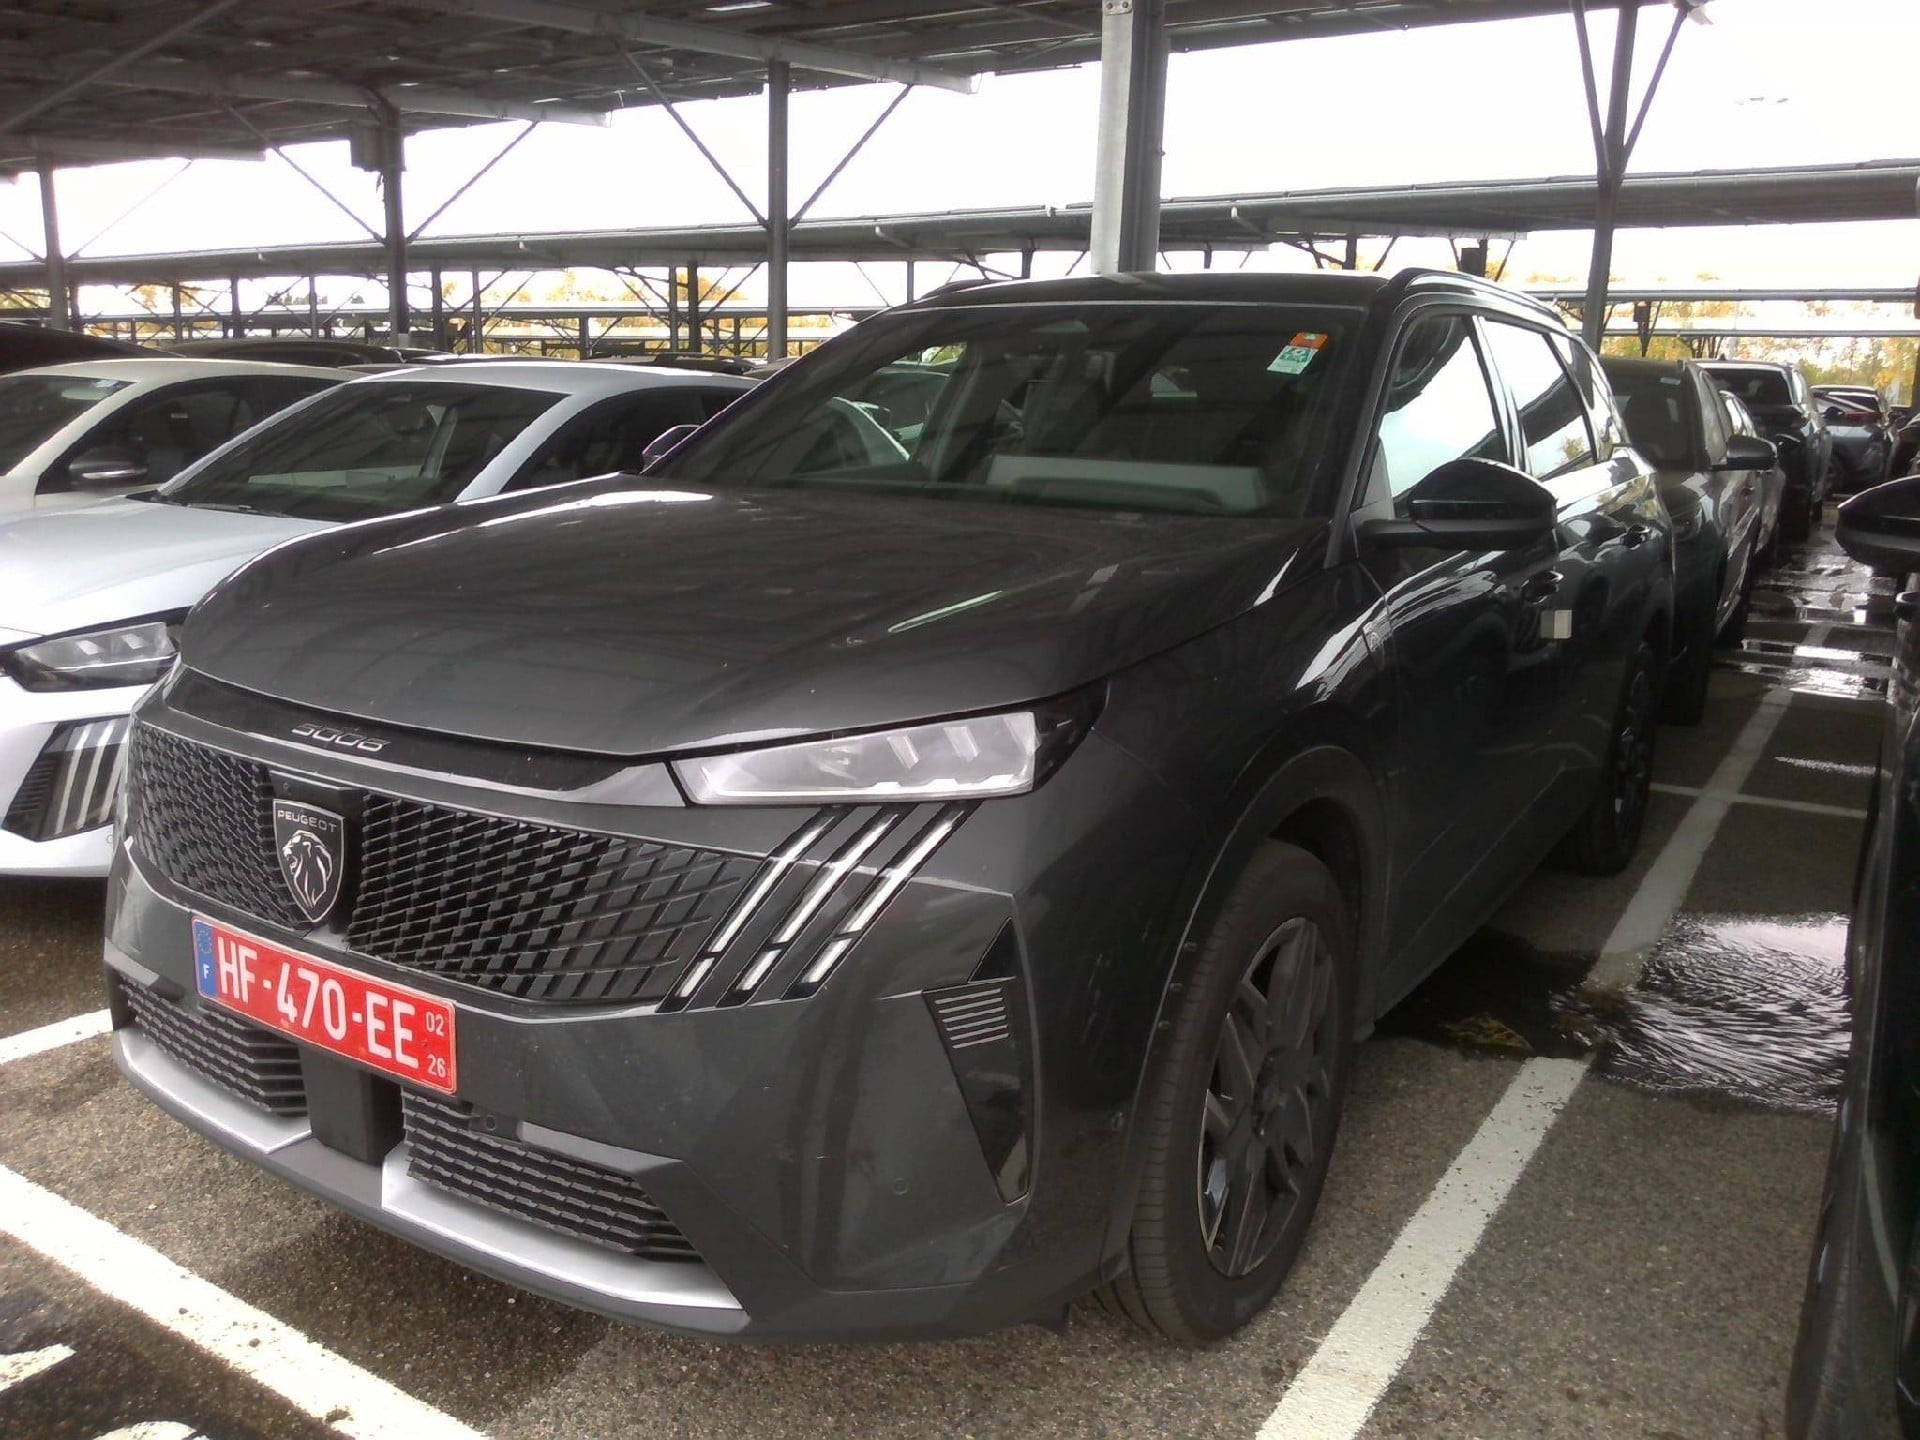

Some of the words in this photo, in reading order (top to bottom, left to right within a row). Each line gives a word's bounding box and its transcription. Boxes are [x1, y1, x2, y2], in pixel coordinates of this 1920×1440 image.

[277, 809, 337, 833] PEUGEOT
[202, 963, 210, 979] F
[217, 936, 420, 1069] HF-470-EE
[425, 1011, 445, 1037] 02
[427, 1053, 447, 1079] 26
